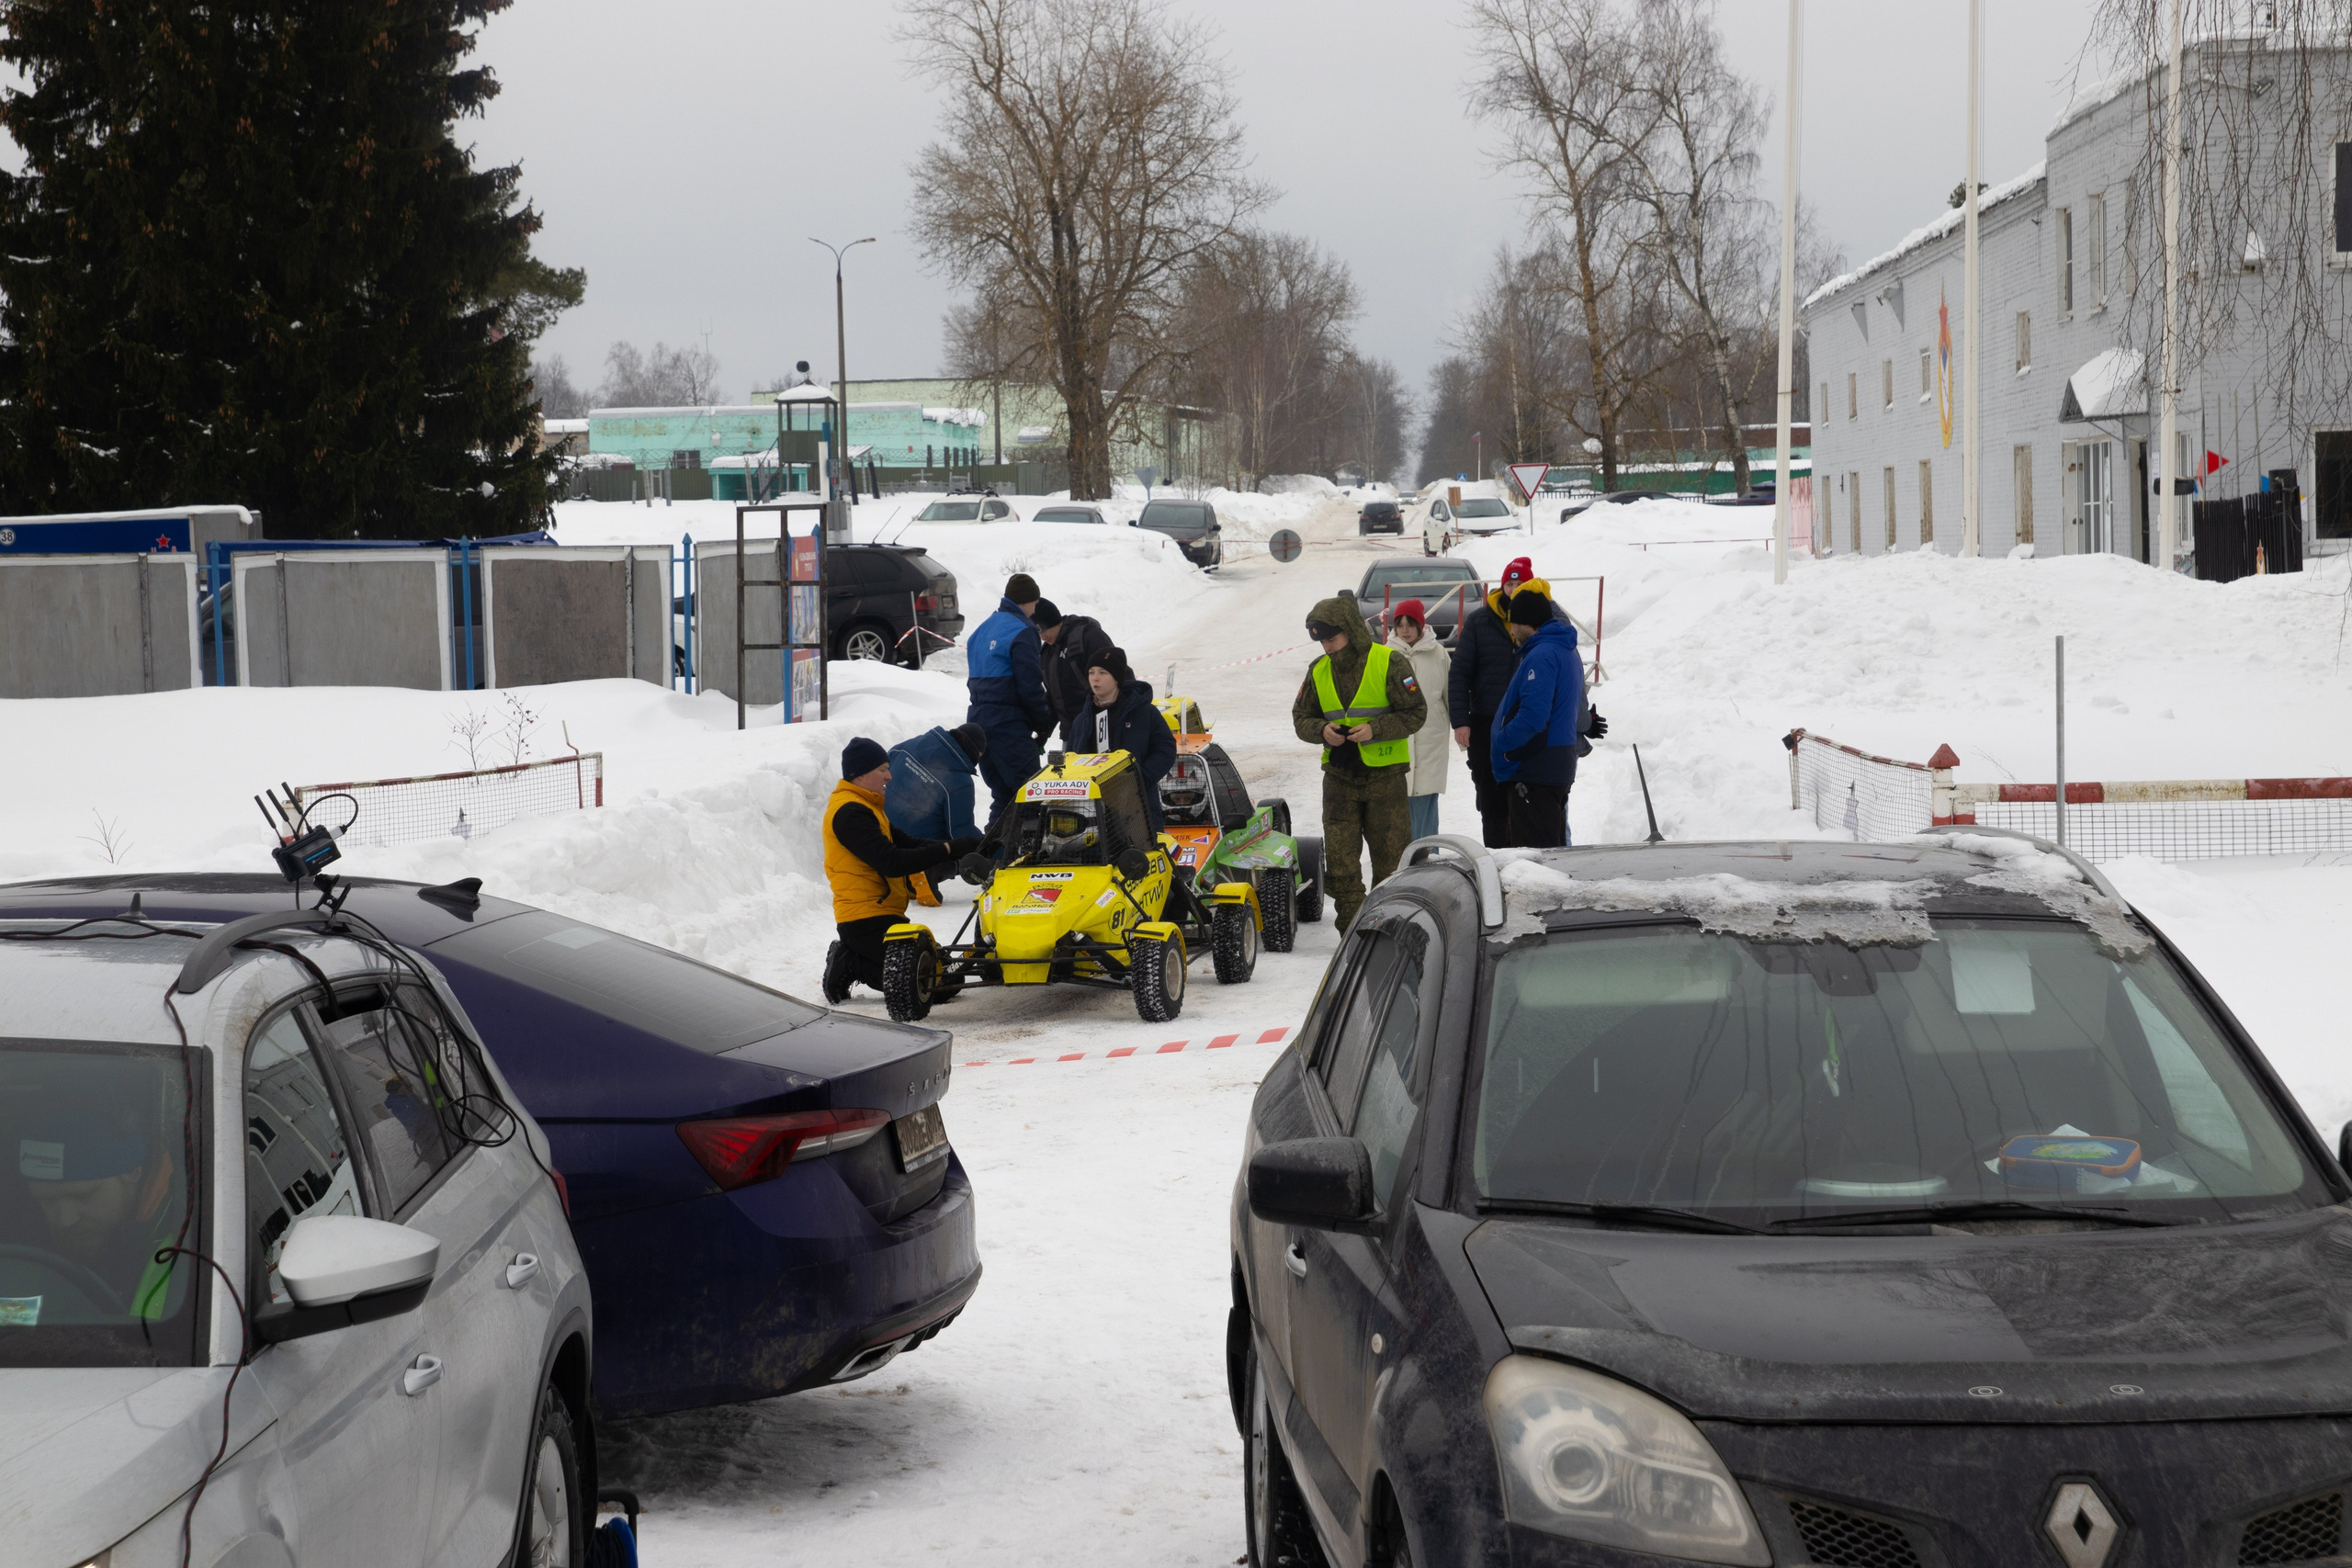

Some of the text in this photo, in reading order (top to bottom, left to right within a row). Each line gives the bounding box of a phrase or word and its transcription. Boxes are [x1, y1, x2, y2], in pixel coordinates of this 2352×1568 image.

[1, 531, 13, 542] 38
[1099, 716, 1107, 743] 81
[1111, 908, 1125, 930] 81
